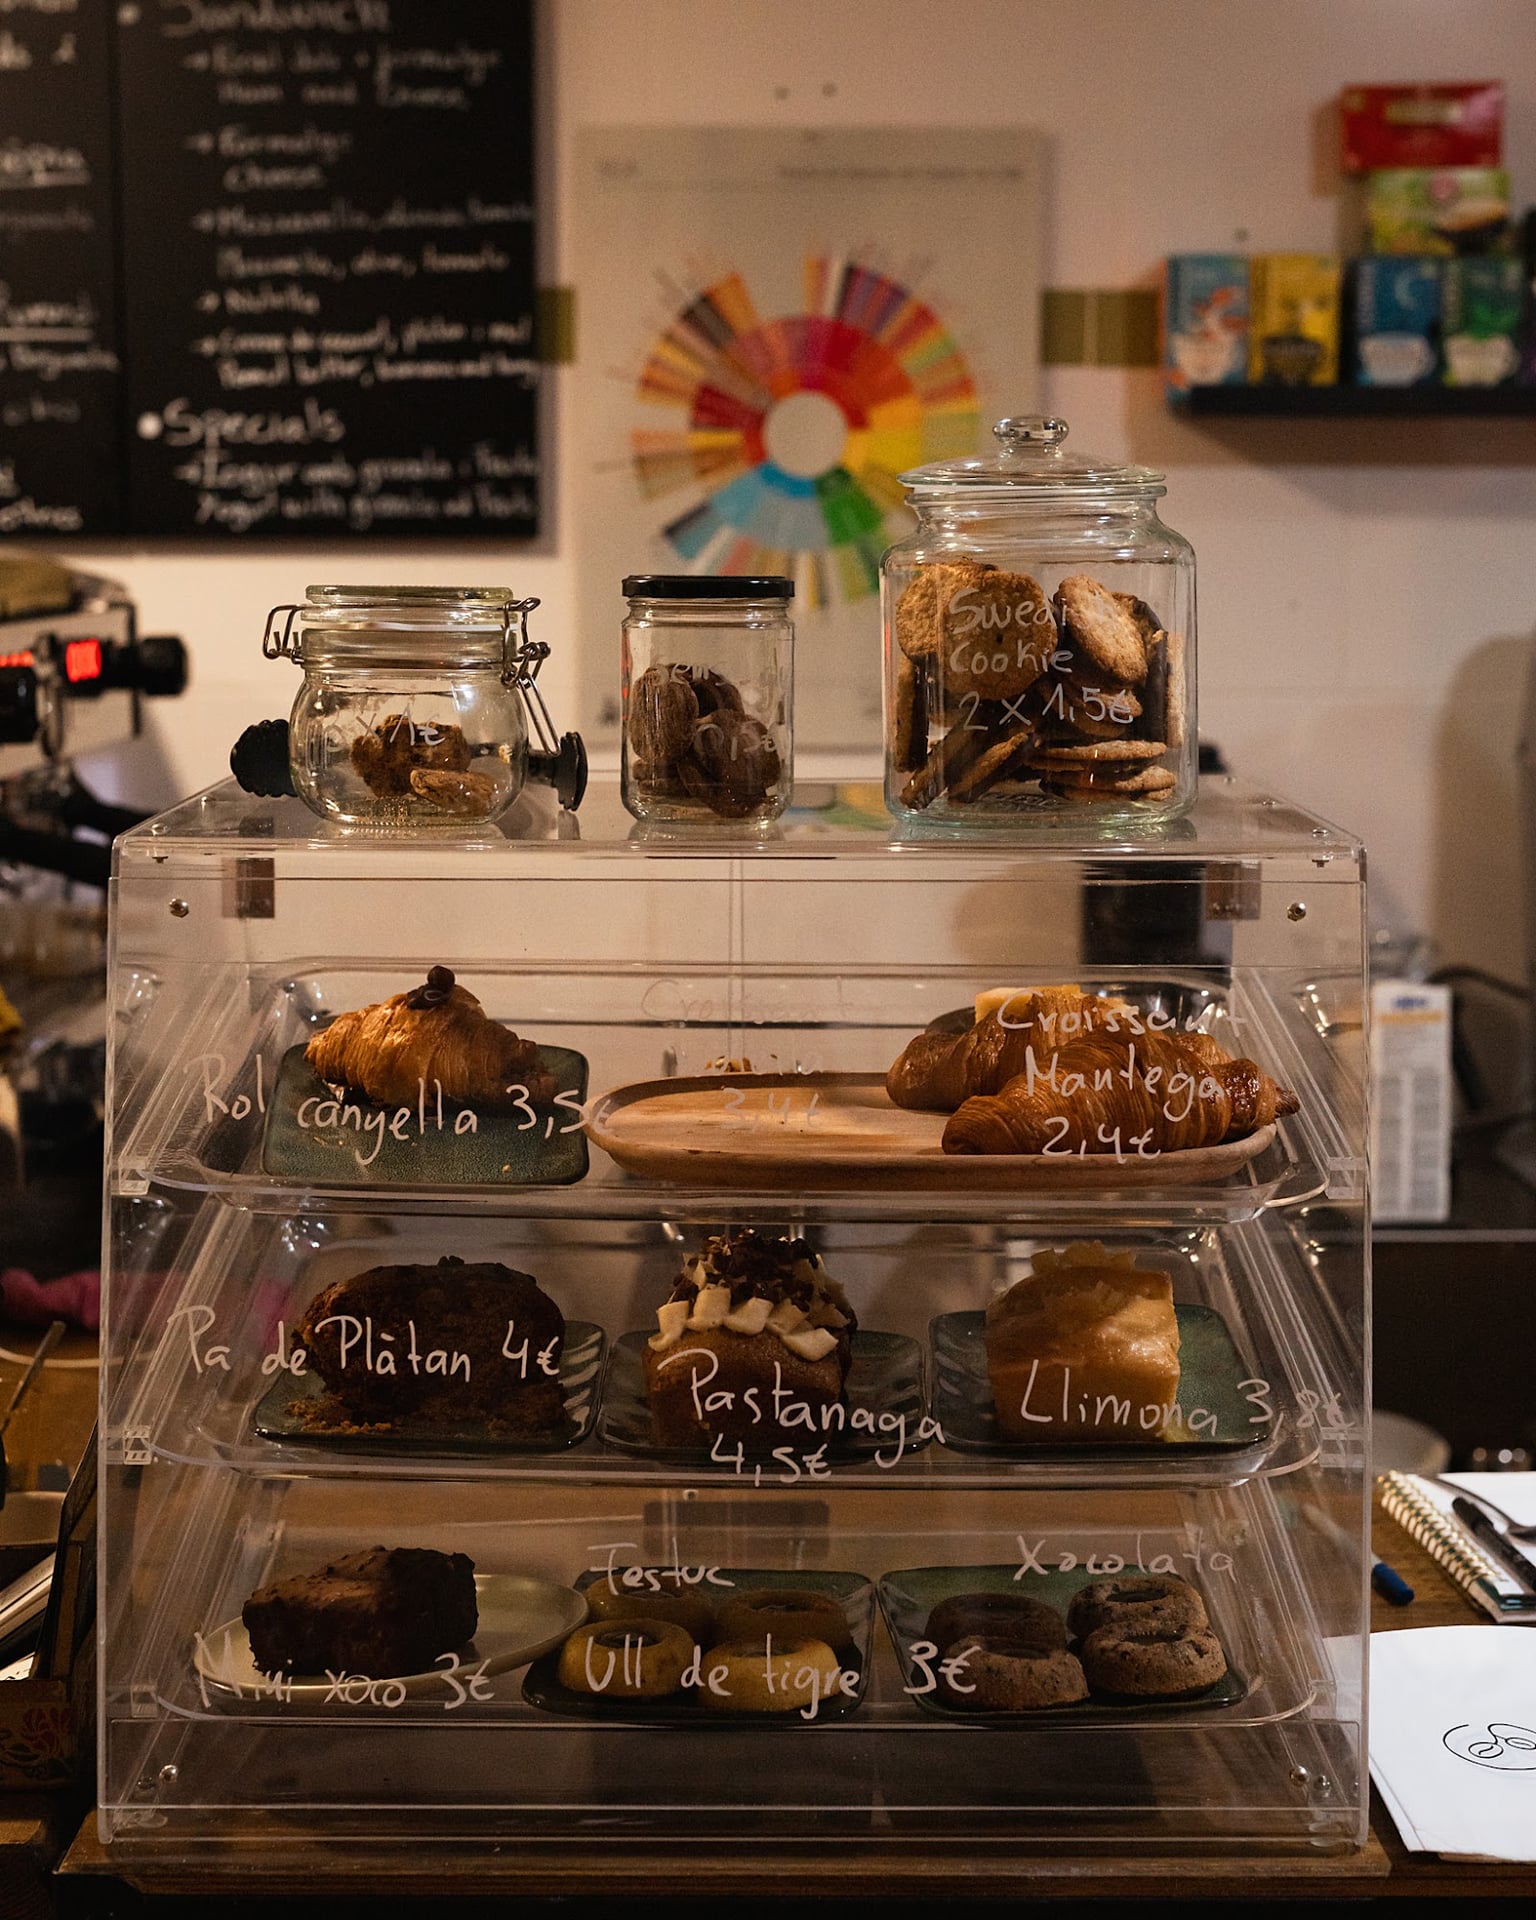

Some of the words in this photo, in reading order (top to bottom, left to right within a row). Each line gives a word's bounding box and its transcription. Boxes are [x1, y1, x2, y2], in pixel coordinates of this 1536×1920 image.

[163, 397, 345, 451] Specials
[949, 639, 1074, 674] Cookie
[957, 690, 989, 732] 2
[1041, 682, 1134, 725] 1,5€
[996, 988, 1248, 1037] Croissant
[182, 1052, 267, 1124] Rol
[297, 1076, 480, 1166] canyella
[504, 1082, 613, 1139] 3,5€
[1024, 1042, 1225, 1122] Mantega
[1040, 1115, 1162, 1165] 2,4€
[166, 1304, 232, 1374] Pa
[260, 1319, 308, 1377] de
[313, 1314, 472, 1383] Plàtan
[500, 1319, 561, 1380] 4€
[655, 1347, 947, 1470] Pastanaga
[1020, 1358, 1219, 1437] Llimona
[709, 1432, 833, 1488] 4,5€
[1011, 1532, 1239, 1585] Xocolata
[433, 1651, 496, 1710] 3€
[584, 1632, 645, 1693] Ull
[679, 1643, 735, 1698] de
[761, 1631, 862, 1721] tigre
[902, 1639, 984, 1695] 3€
